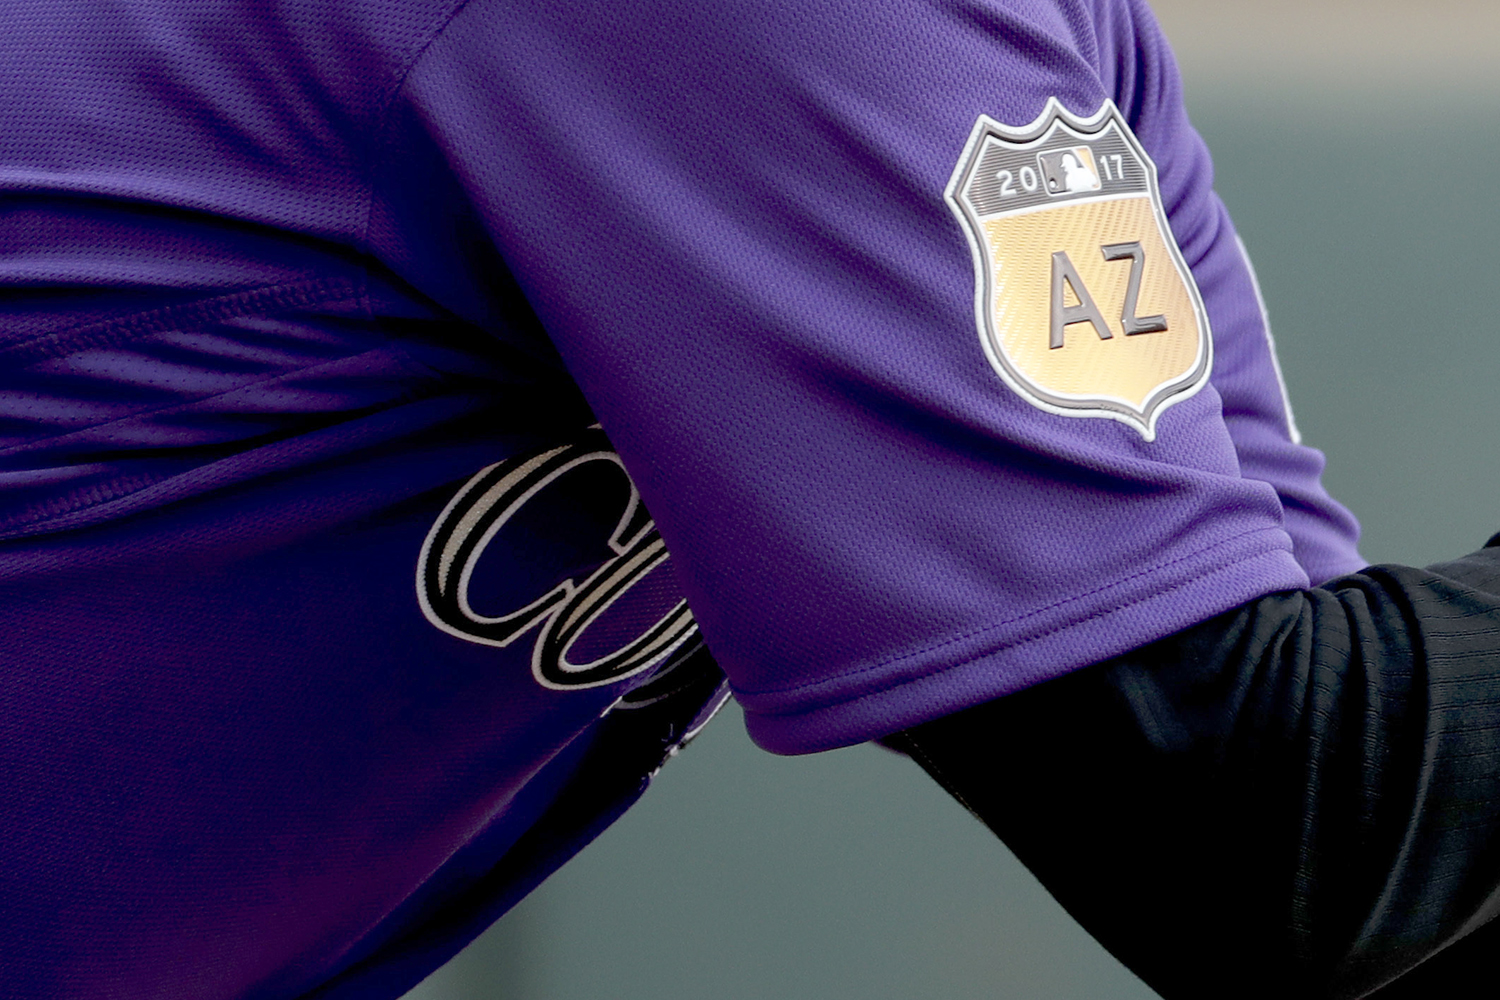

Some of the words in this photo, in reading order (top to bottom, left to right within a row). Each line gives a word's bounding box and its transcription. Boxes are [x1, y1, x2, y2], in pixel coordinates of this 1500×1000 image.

[995, 165, 1039, 197] 20
[1099, 153, 1125, 181] 17
[1049, 240, 1169, 350] AZ
